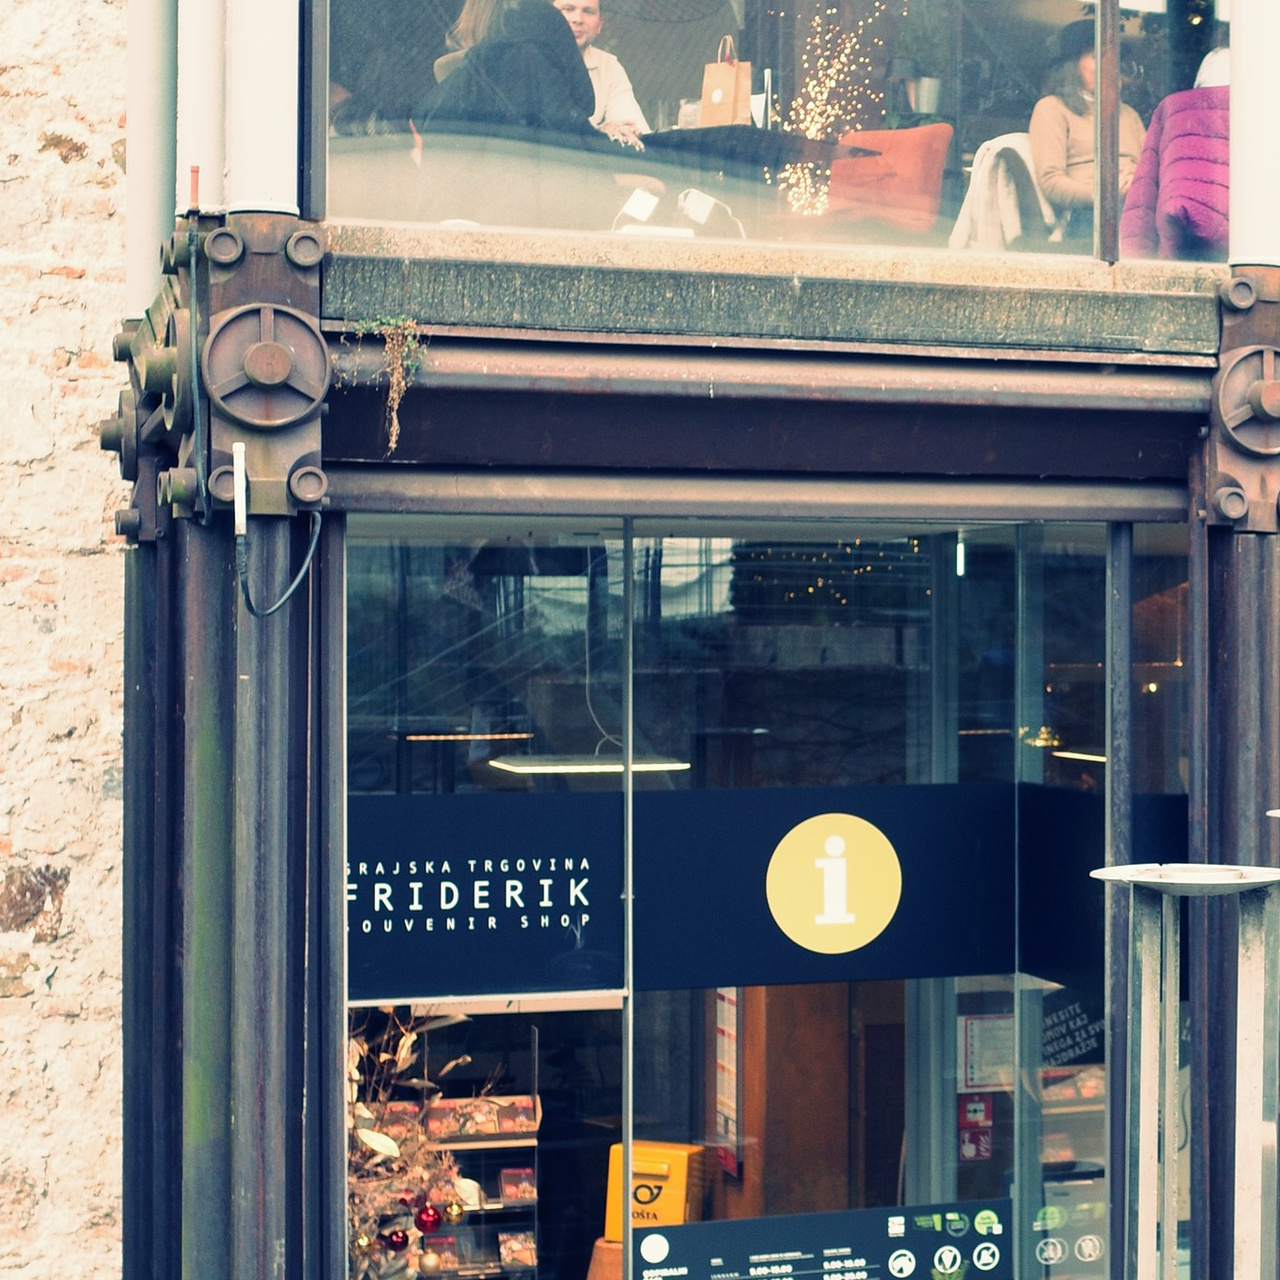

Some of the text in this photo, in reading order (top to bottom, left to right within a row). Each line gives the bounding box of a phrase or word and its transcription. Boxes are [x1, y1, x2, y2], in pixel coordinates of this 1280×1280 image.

[468, 857, 590, 873] TRGOVINA
[347, 913, 590, 934] OUVENIR SHOP
[631, 1209, 659, 1221] OŠTA
